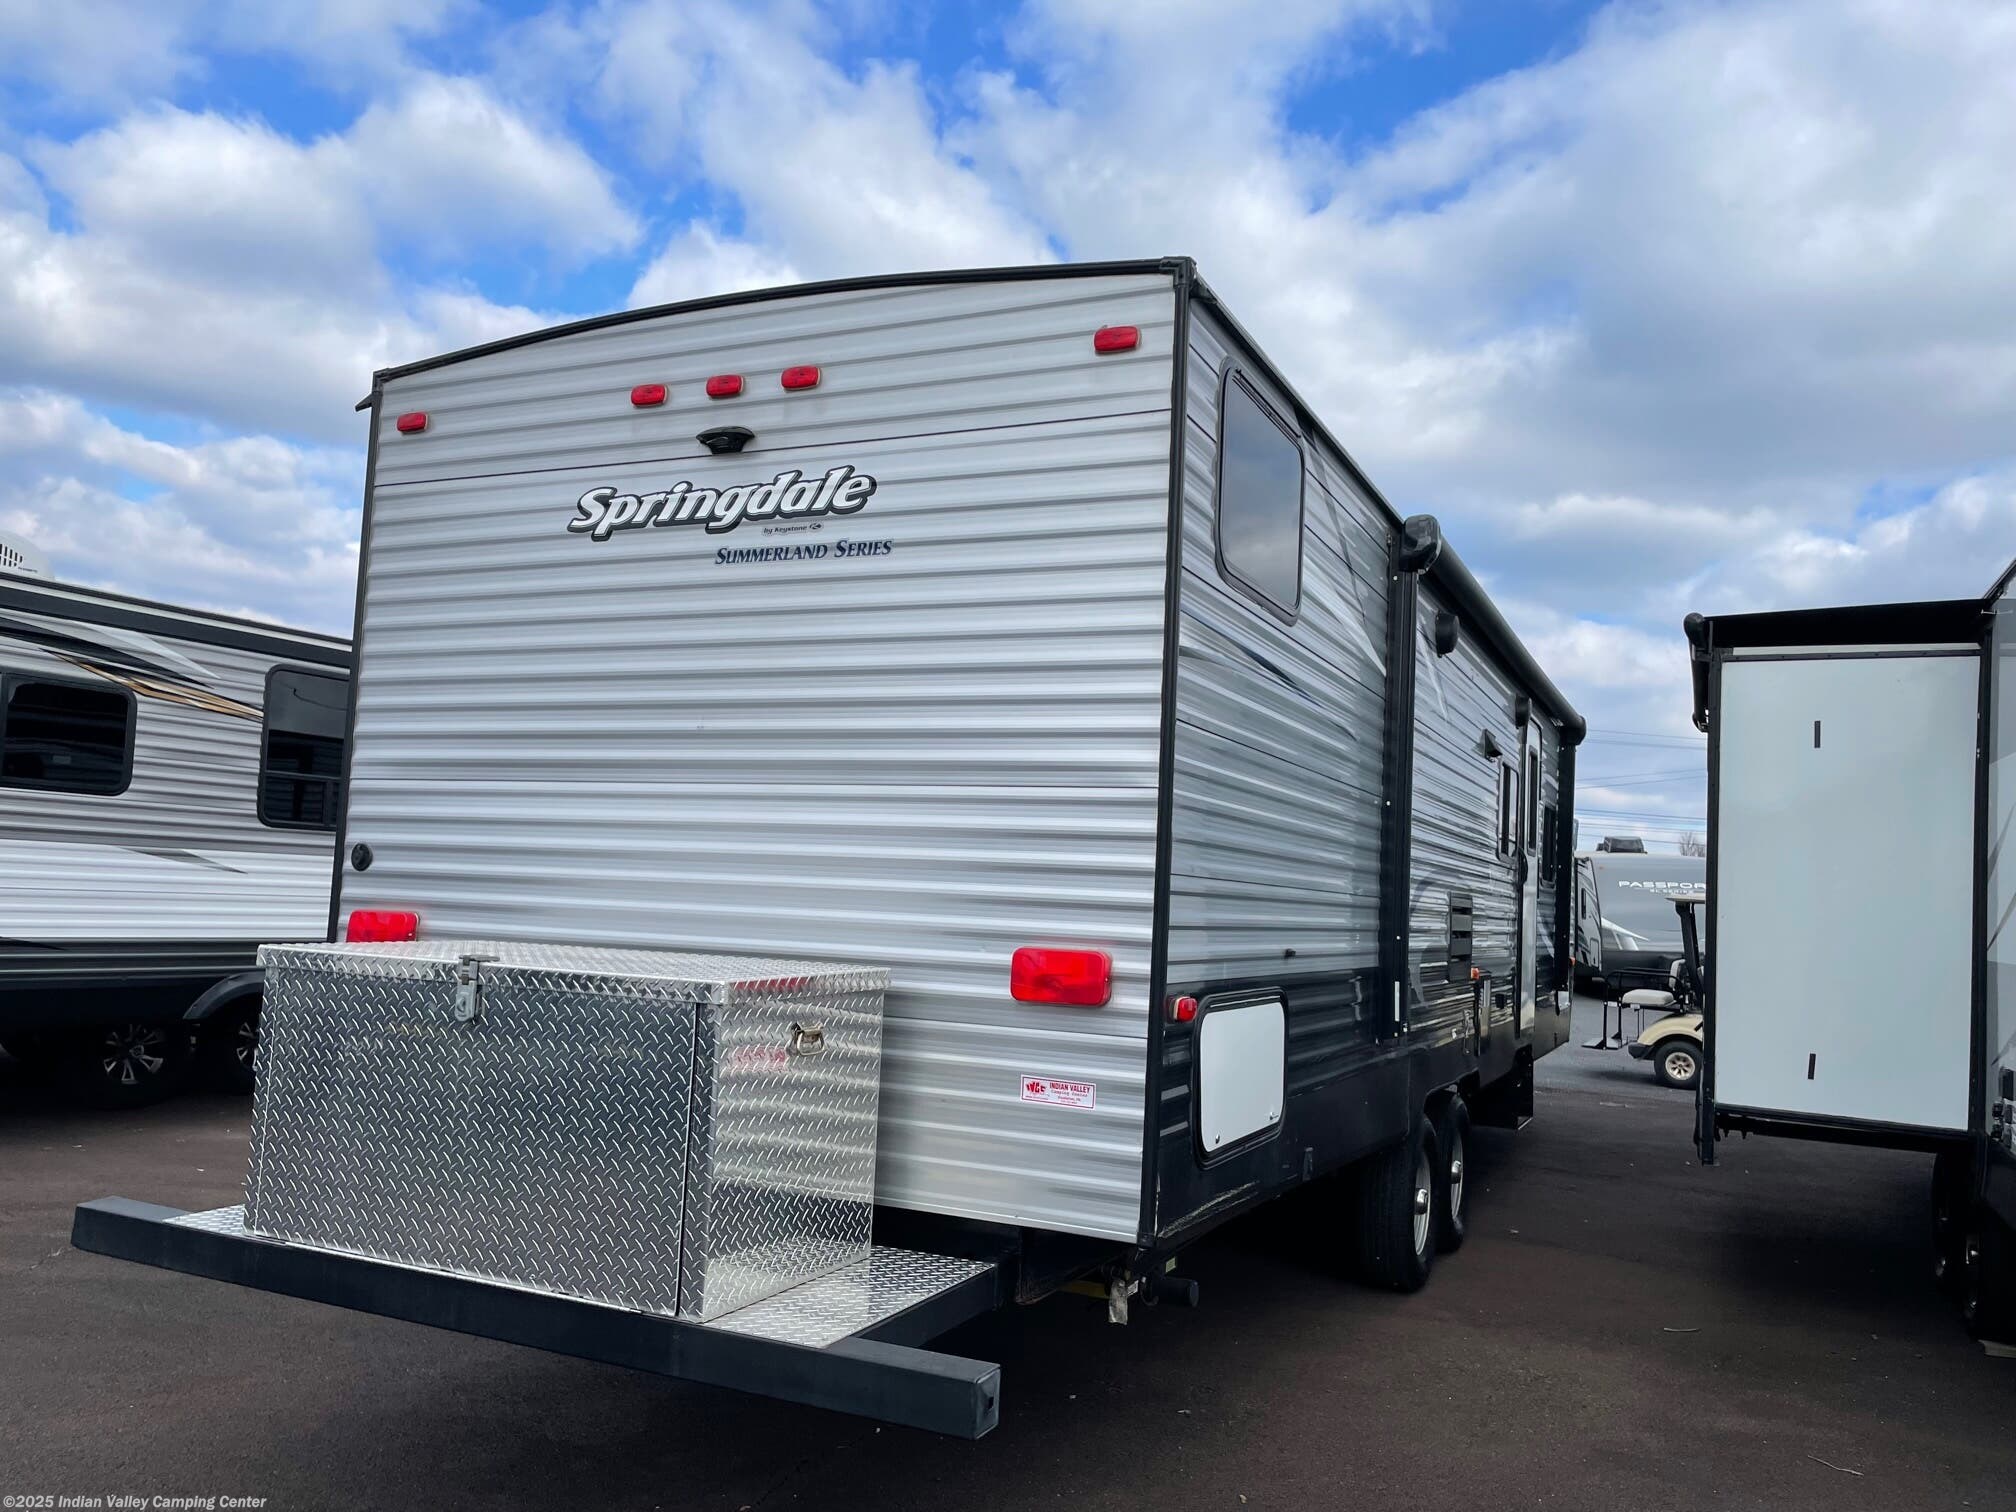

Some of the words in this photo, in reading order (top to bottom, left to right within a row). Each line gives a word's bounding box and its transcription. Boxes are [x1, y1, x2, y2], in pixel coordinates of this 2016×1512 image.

[567, 465, 877, 541] Springdale
[714, 543, 828, 565] SUMMERLAND
[833, 539, 893, 558] SERIES
[1618, 881, 1706, 889] PASSPOR
[1050, 1082, 1069, 1091] INDIAN
[1070, 1084, 1090, 1094] VALLEY
